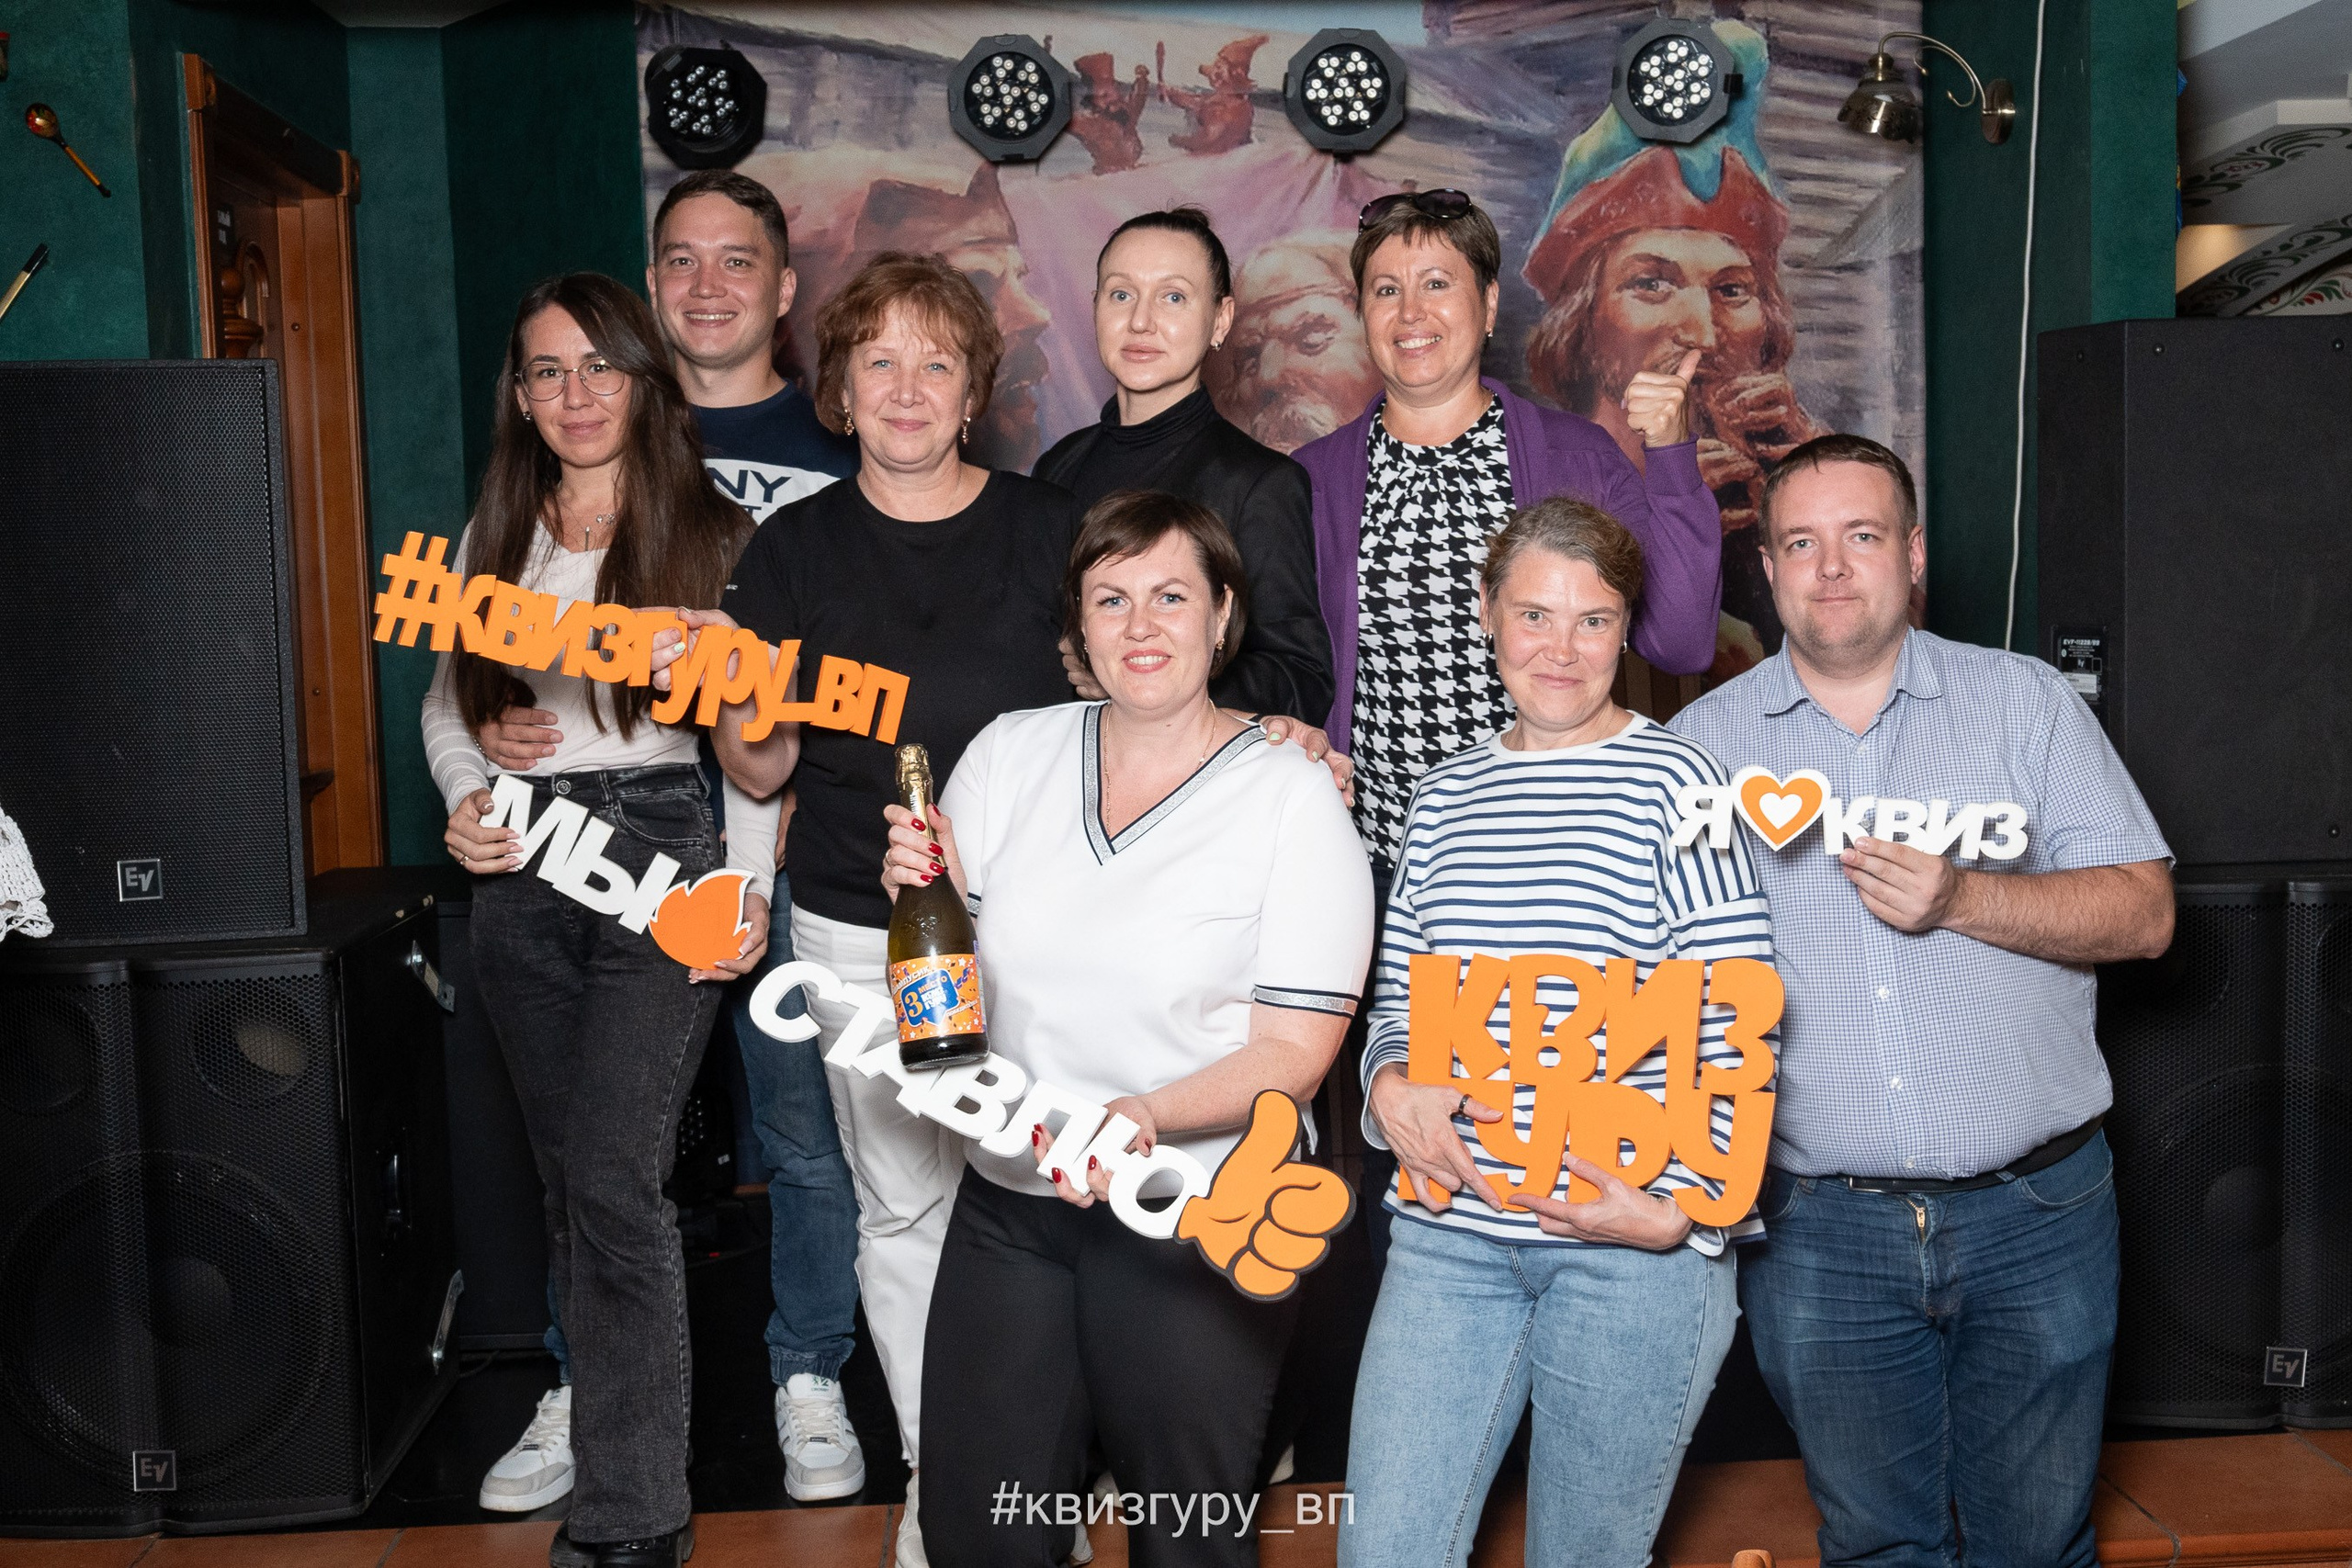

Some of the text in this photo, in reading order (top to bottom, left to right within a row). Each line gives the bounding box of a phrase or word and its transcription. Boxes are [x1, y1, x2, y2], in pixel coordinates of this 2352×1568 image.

[1668, 784, 1735, 851] Я
[125, 866, 154, 892] EV
[904, 991, 923, 1018] 3
[1408, 953, 1785, 1093] КВИЗ
[2272, 1354, 2300, 1379] EV
[141, 1458, 168, 1483] EV
